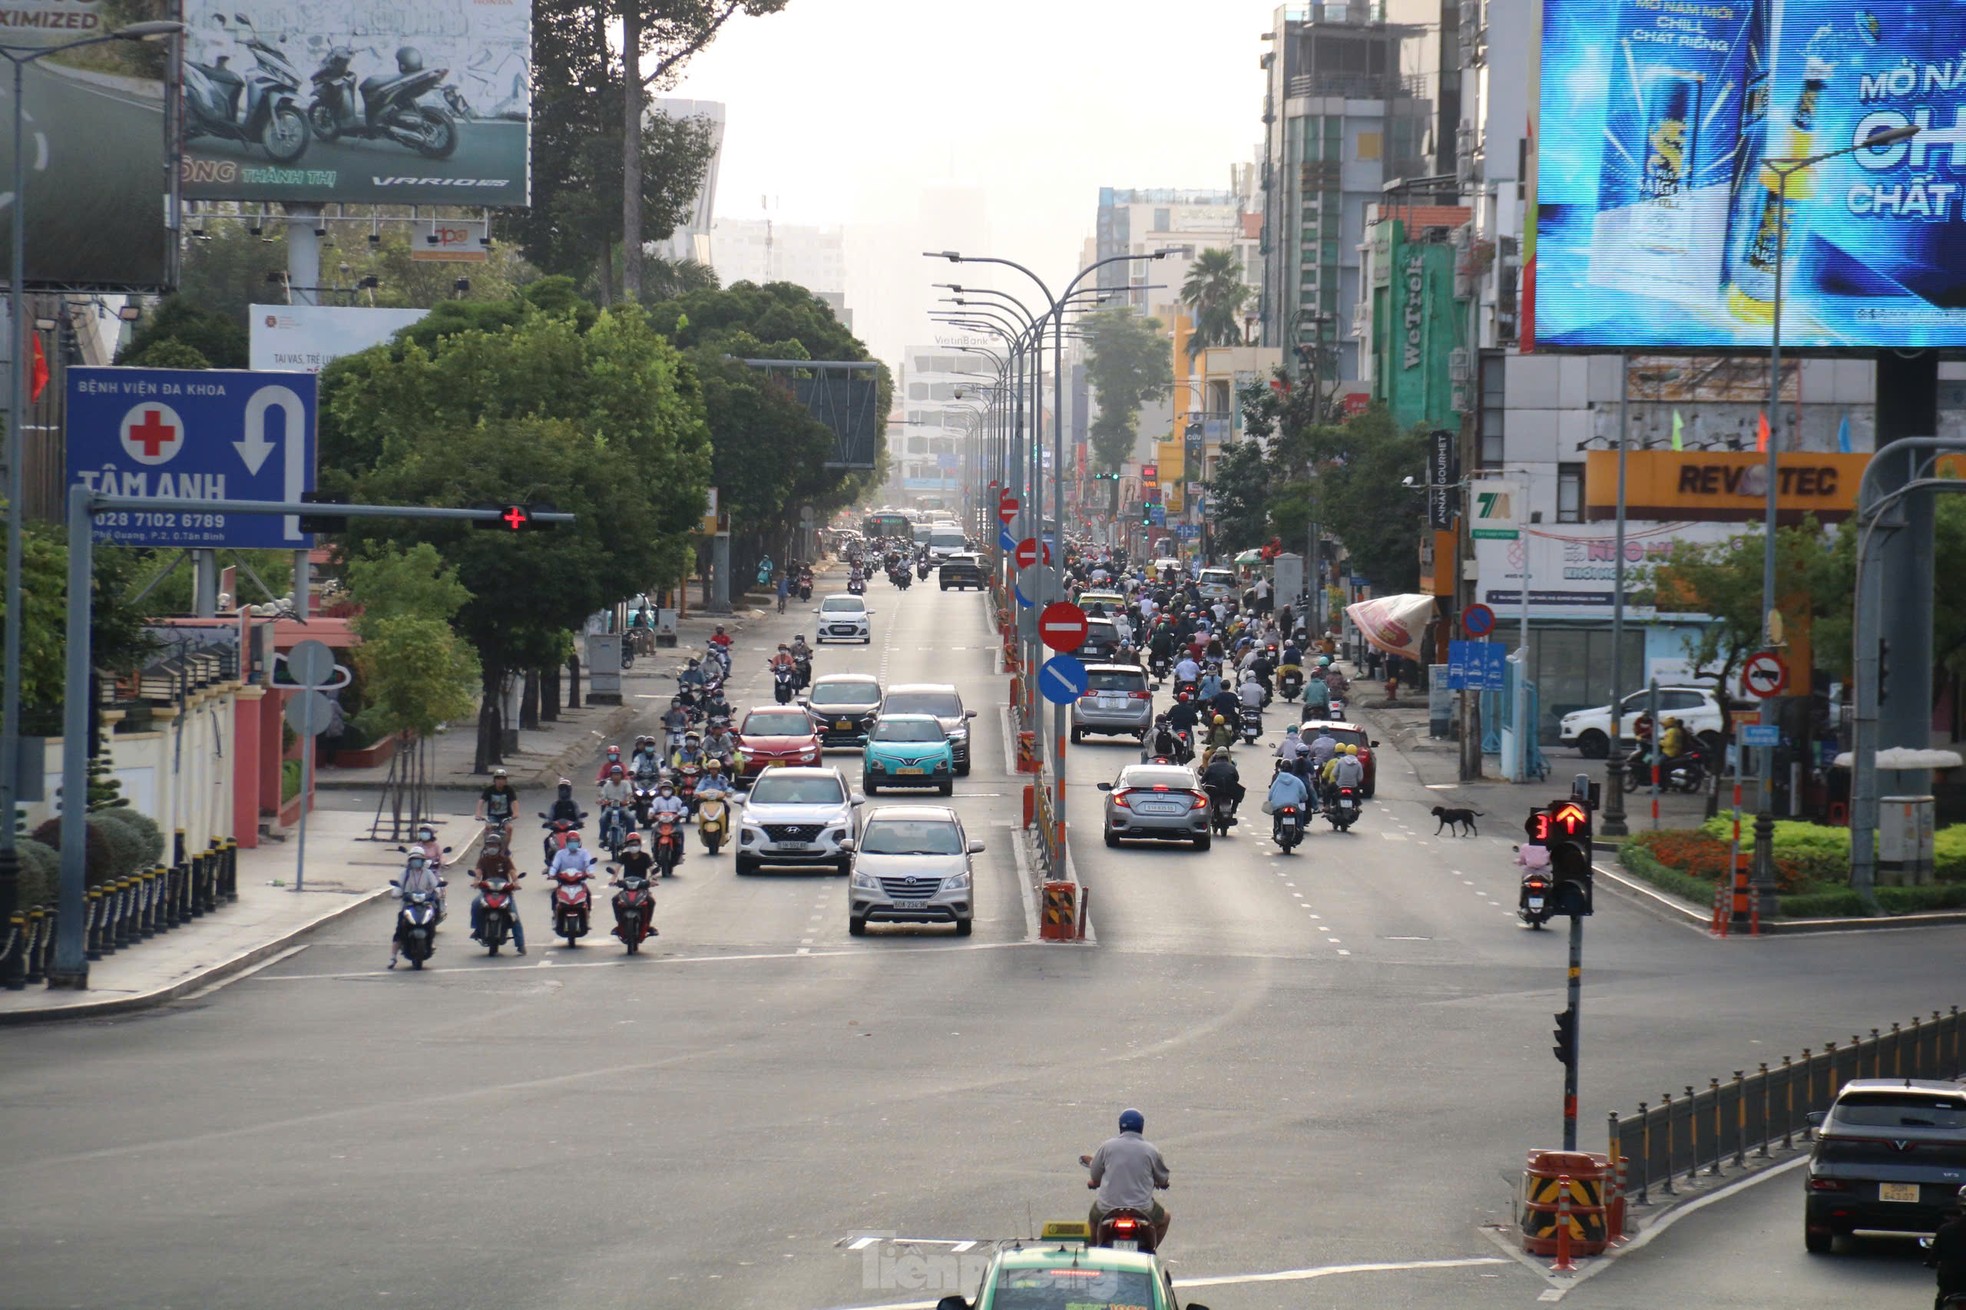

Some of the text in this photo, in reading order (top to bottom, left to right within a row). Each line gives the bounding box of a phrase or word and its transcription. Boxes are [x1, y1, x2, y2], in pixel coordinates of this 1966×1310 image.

[1656, 16, 1707, 34] CHILL
[1846, 173, 1957, 216] CHẤT
[1404, 256, 1425, 370] WeTrek
[934, 334, 989, 346] VietinBank
[78, 378, 227, 397] BỆNH VIỆN ĐA KHOA
[77, 463, 226, 500] TÂM ANH
[95, 512, 225, 528] 028 7102 6789
